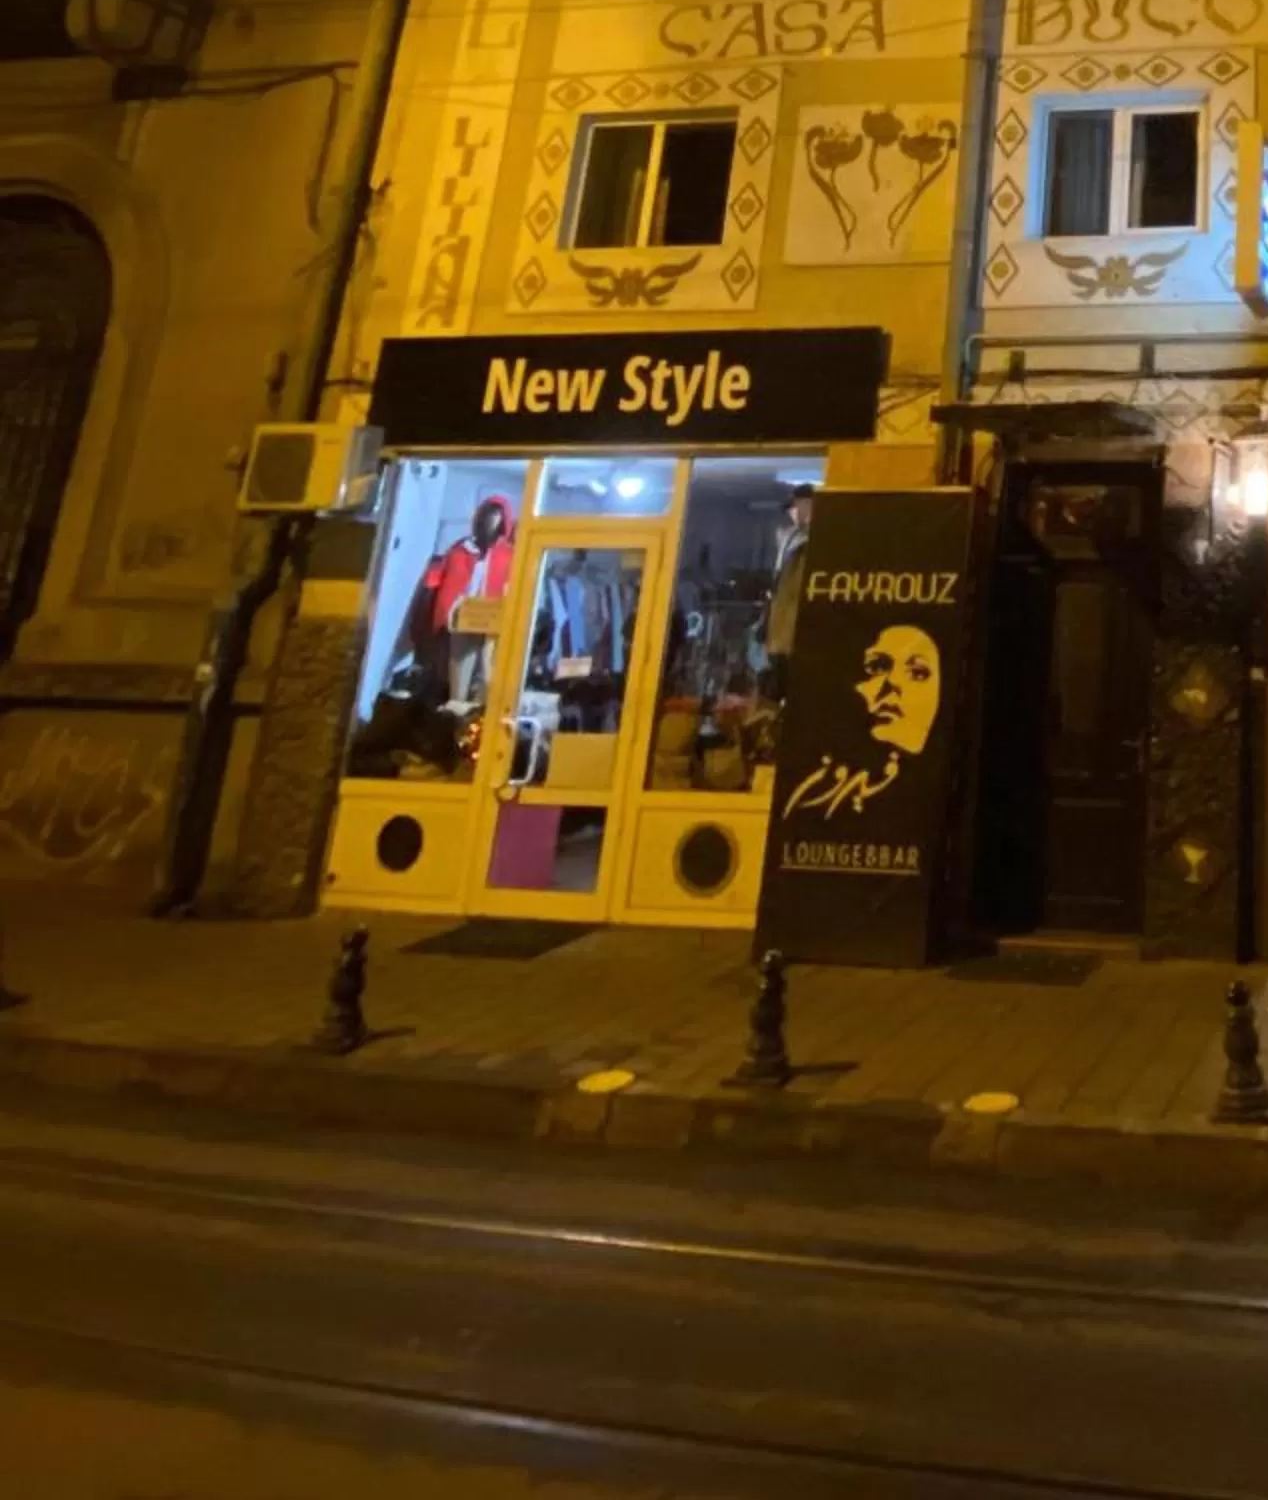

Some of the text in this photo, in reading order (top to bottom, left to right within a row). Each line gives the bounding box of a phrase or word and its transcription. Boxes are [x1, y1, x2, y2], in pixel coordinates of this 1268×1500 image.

[482, 351, 749, 425] New Style
[807, 571, 958, 604] FAYROUZ
